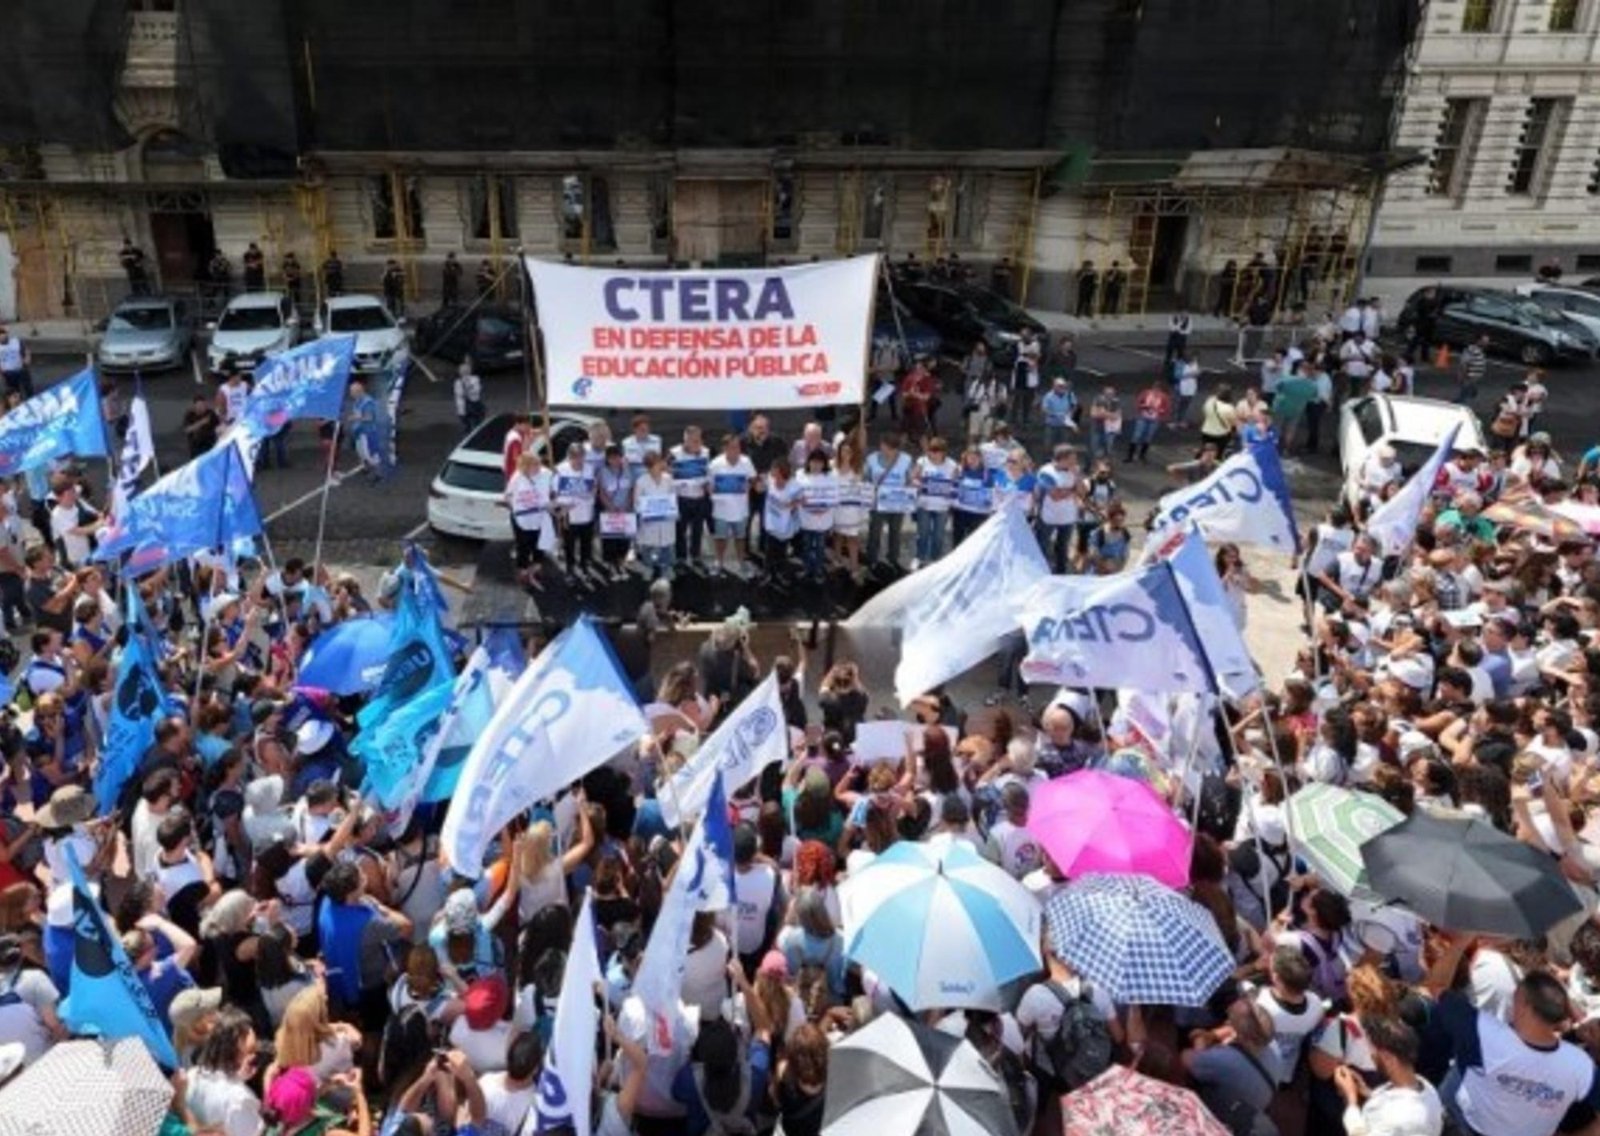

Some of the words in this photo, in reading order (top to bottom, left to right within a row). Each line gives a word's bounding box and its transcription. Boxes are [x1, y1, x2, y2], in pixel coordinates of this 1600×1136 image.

[603, 276, 795, 322] CTERA
[593, 327, 625, 349] EN
[630, 326, 743, 350] DEFENSA
[748, 326, 782, 349] DE
[786, 324, 817, 346] LA
[582, 351, 720, 378] EDUCACIÓN
[725, 350, 829, 378] PÚBLICA
